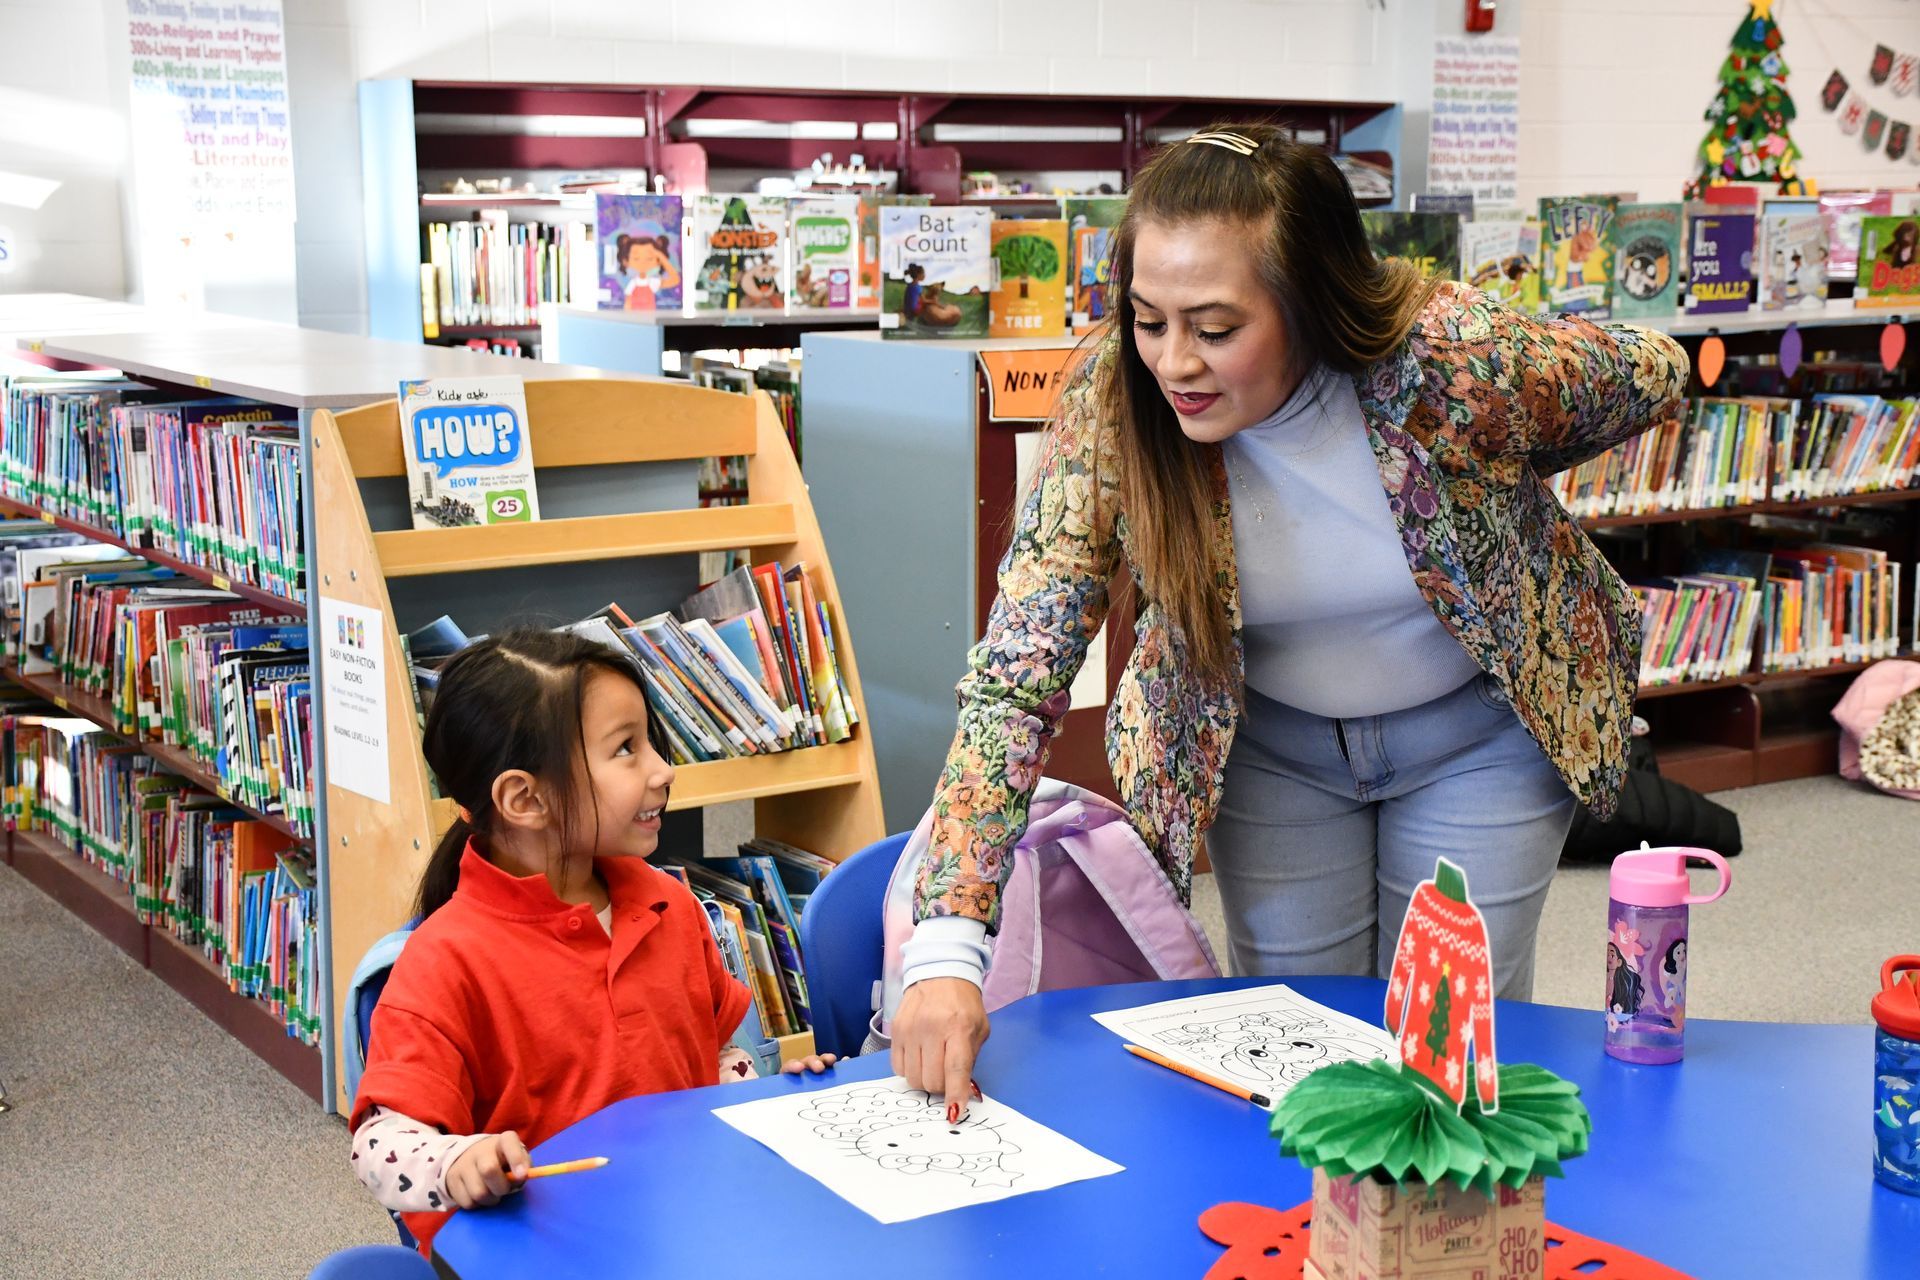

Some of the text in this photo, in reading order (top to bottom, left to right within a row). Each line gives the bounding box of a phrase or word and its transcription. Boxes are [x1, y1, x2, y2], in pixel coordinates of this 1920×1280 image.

[129, 22, 280, 46] 200s-Religion and Prayer
[185, 45, 201, 58] and
[203, 44, 242, 64] Learning
[132, 60, 284, 86] 400s-Words and Languages
[210, 85, 231, 99] and
[221, 132, 250, 146] and
[255, 132, 288, 150] Play
[919, 215, 955, 233] Bat
[1549, 205, 1615, 242] LEFTY
[709, 231, 778, 249] MONSTER
[904, 234, 968, 253] Count
[1692, 260, 1721, 282] you
[1005, 316, 1043, 329] TREE
[1004, 371, 1048, 392] NON
[437, 390, 462, 401] Kids
[420, 411, 514, 459] HOW?
[449, 477, 479, 489] HOW
[497, 499, 518, 514] 25
[229, 609, 261, 621] THE
[342, 652, 376, 670] NON-FICTION
[344, 670, 363, 685] BOOKS
[1444, 1237, 1471, 1253] PARTY
